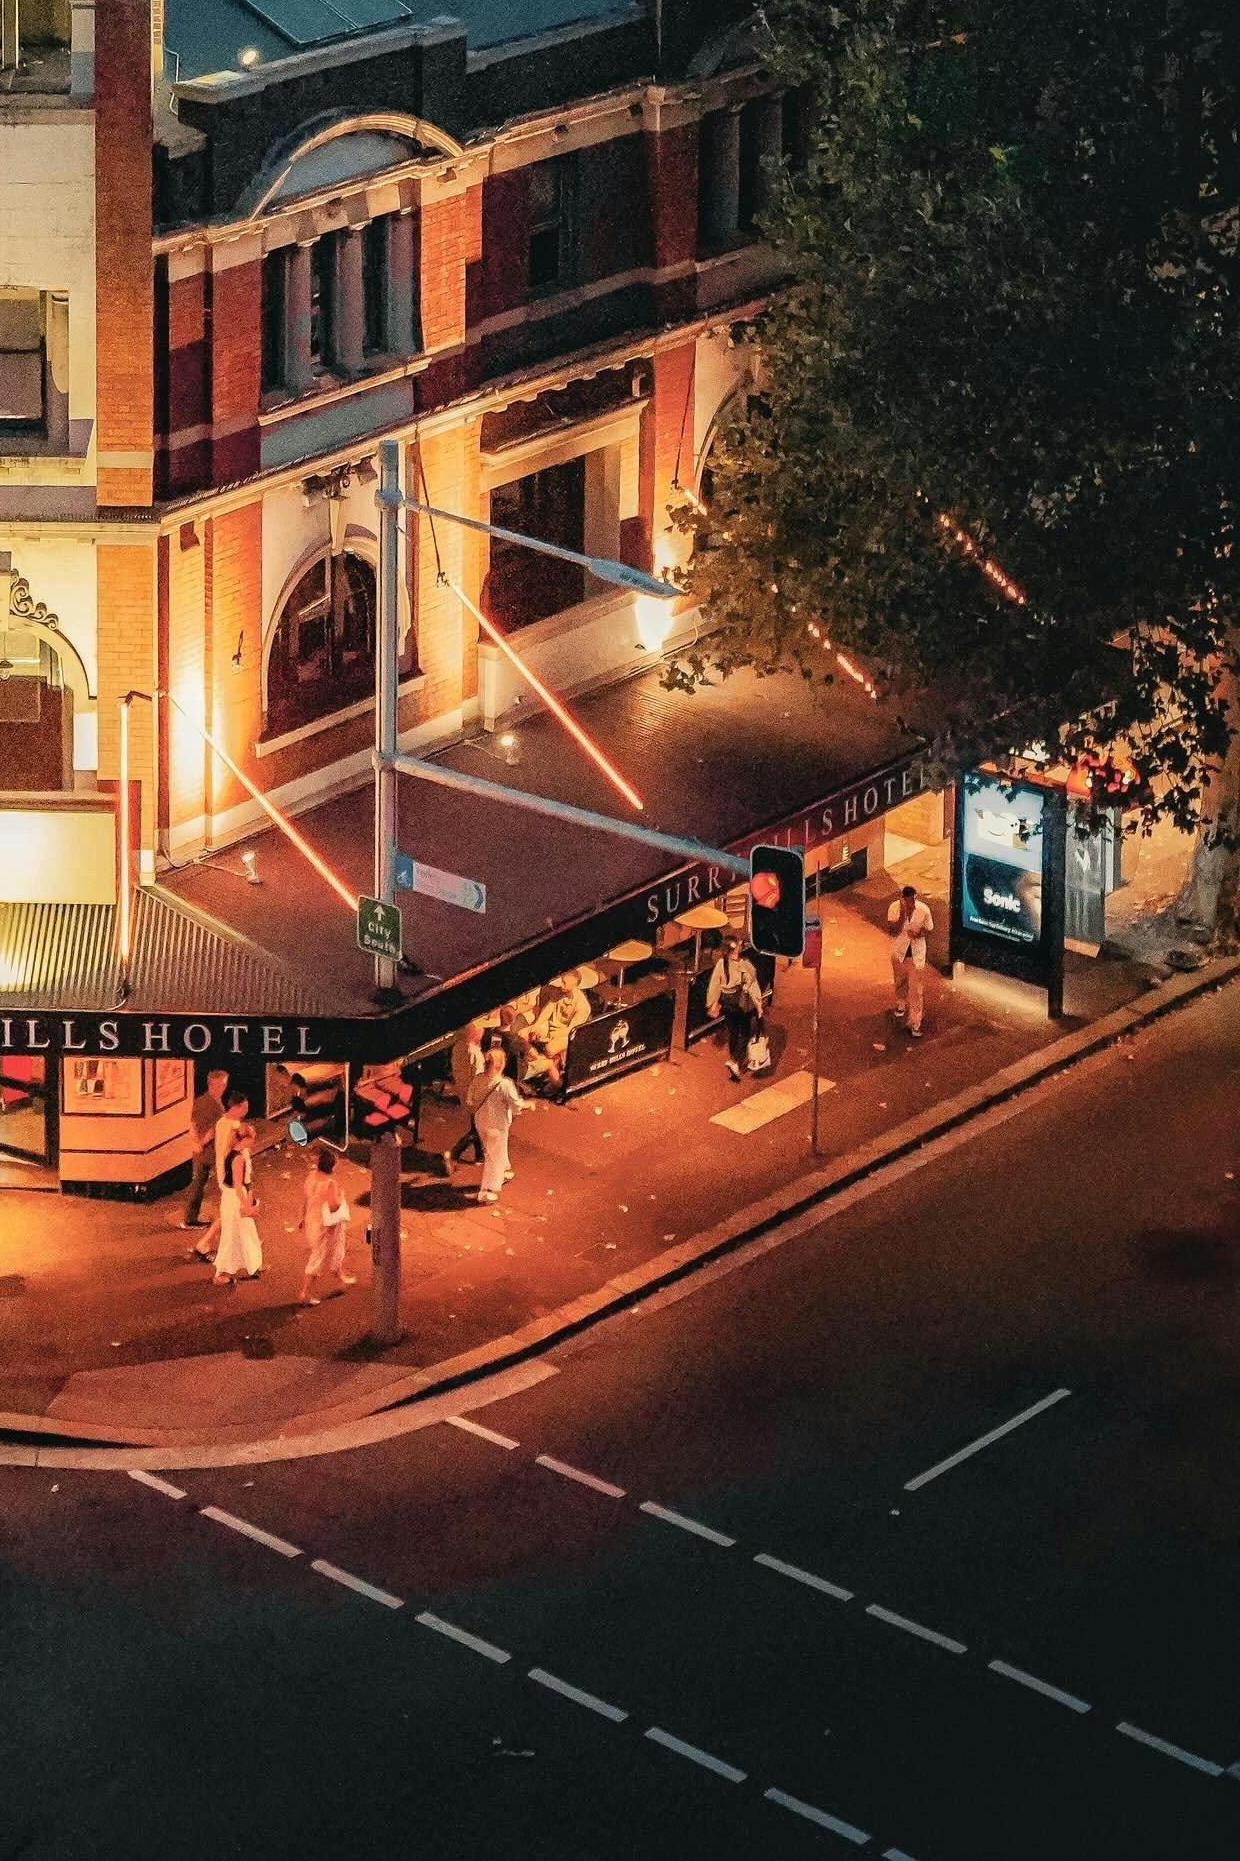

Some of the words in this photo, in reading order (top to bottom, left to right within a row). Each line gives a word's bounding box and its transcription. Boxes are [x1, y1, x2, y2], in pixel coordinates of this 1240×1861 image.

[646, 860, 740, 924] SURR
[982, 885, 1022, 914] Sonic
[367, 920, 392, 940] City
[141, 1022, 322, 1055] HOTEL
